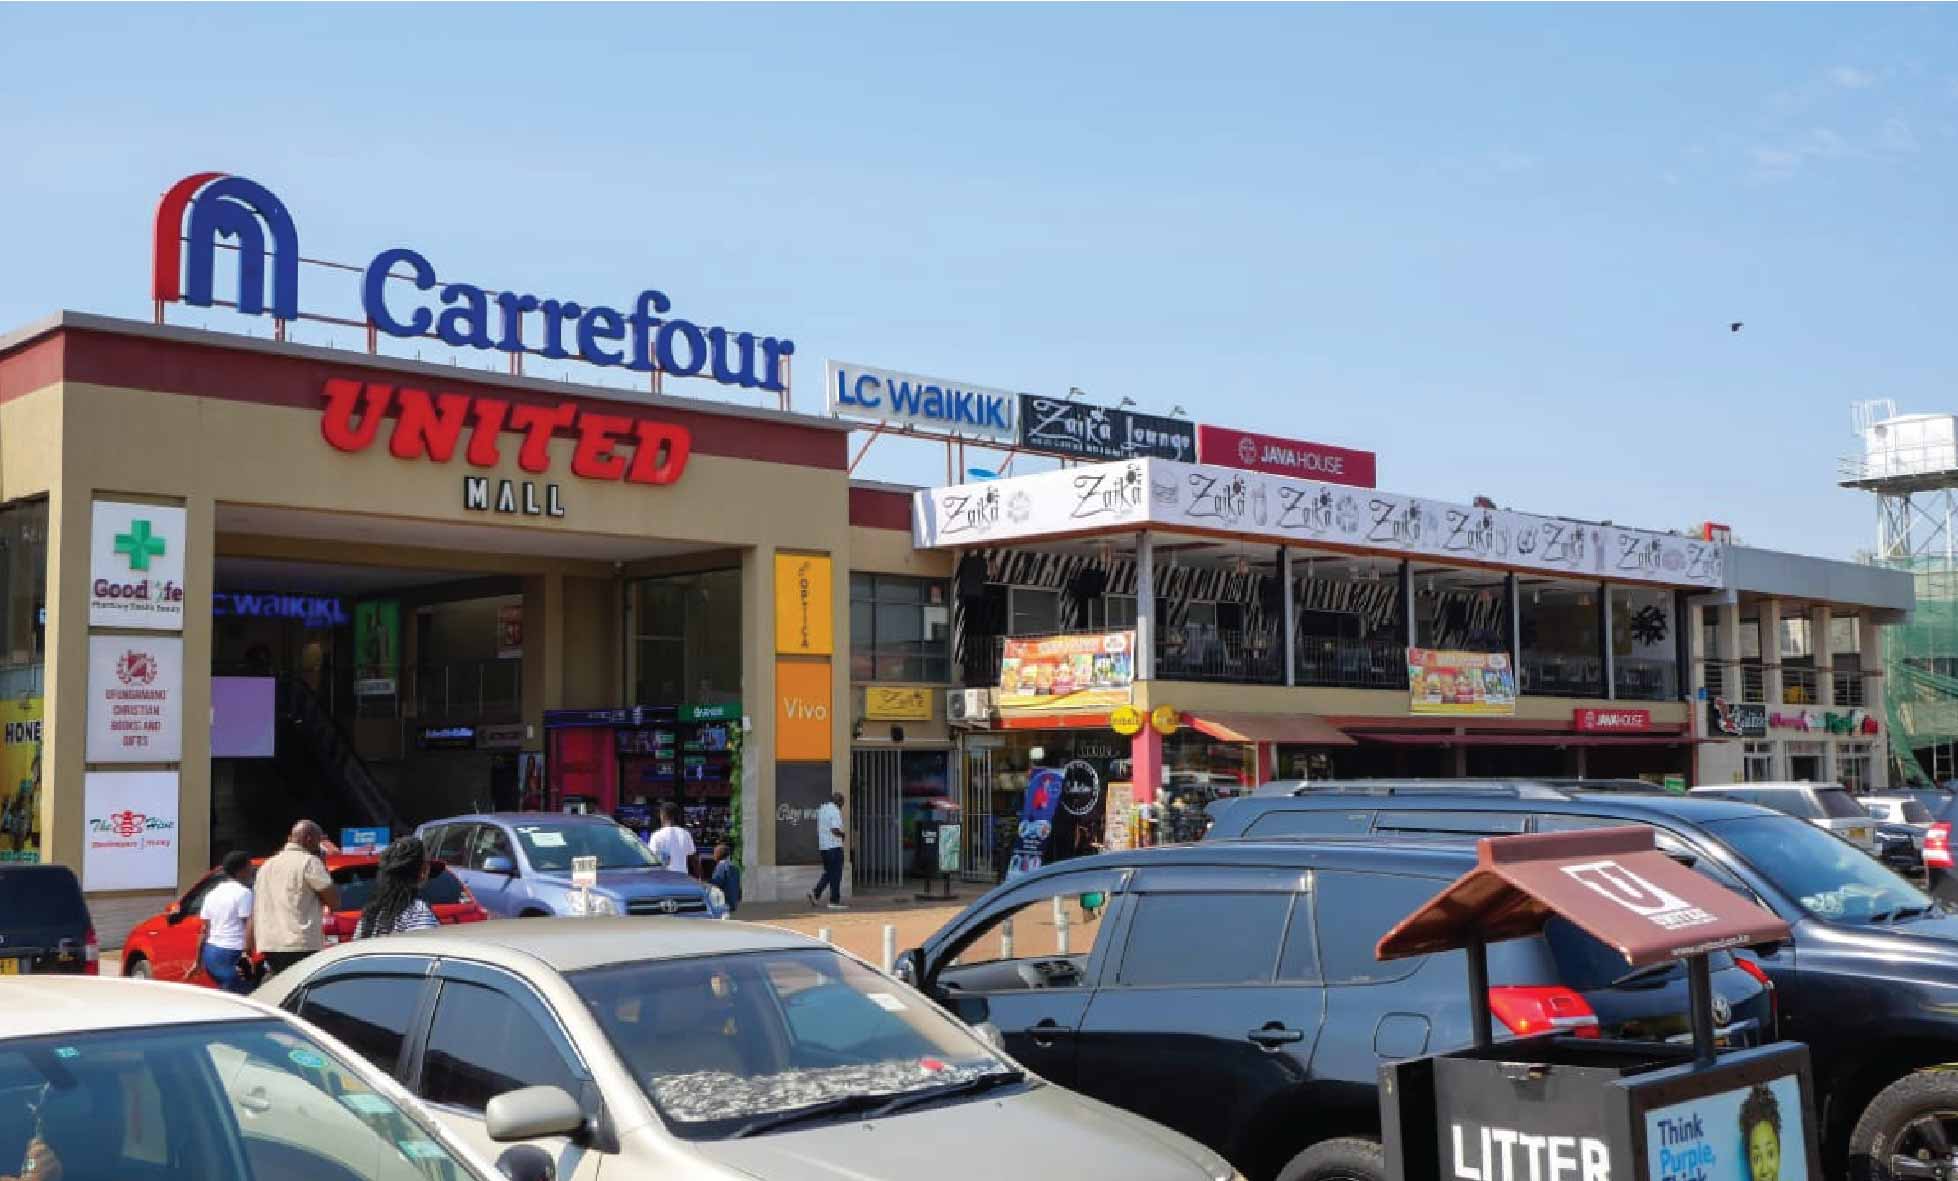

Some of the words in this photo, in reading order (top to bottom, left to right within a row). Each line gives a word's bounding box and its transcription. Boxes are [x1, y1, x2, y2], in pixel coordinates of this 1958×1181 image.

[361, 248, 795, 391] Carrefour
[838, 369, 881, 408] LC
[321, 378, 693, 485] UNITED
[1028, 400, 1111, 446] Zaika
[1260, 445, 1297, 468] JAVA
[1298, 452, 1345, 475] HOUSE
[464, 477, 565, 517] MALL
[942, 492, 999, 534] Zaika
[1070, 471, 1142, 520] Zaika
[1184, 473, 1245, 518] Zaika
[1277, 486, 1332, 529] Zaika
[1366, 499, 1420, 542] Zaika
[94, 578, 183, 601] Goodfe
[783, 696, 827, 721] Vivo
[1657, 1112, 1704, 1147] Think
[1452, 1124, 1611, 1181] LITTER
[1659, 1141, 1717, 1175] Purple,
